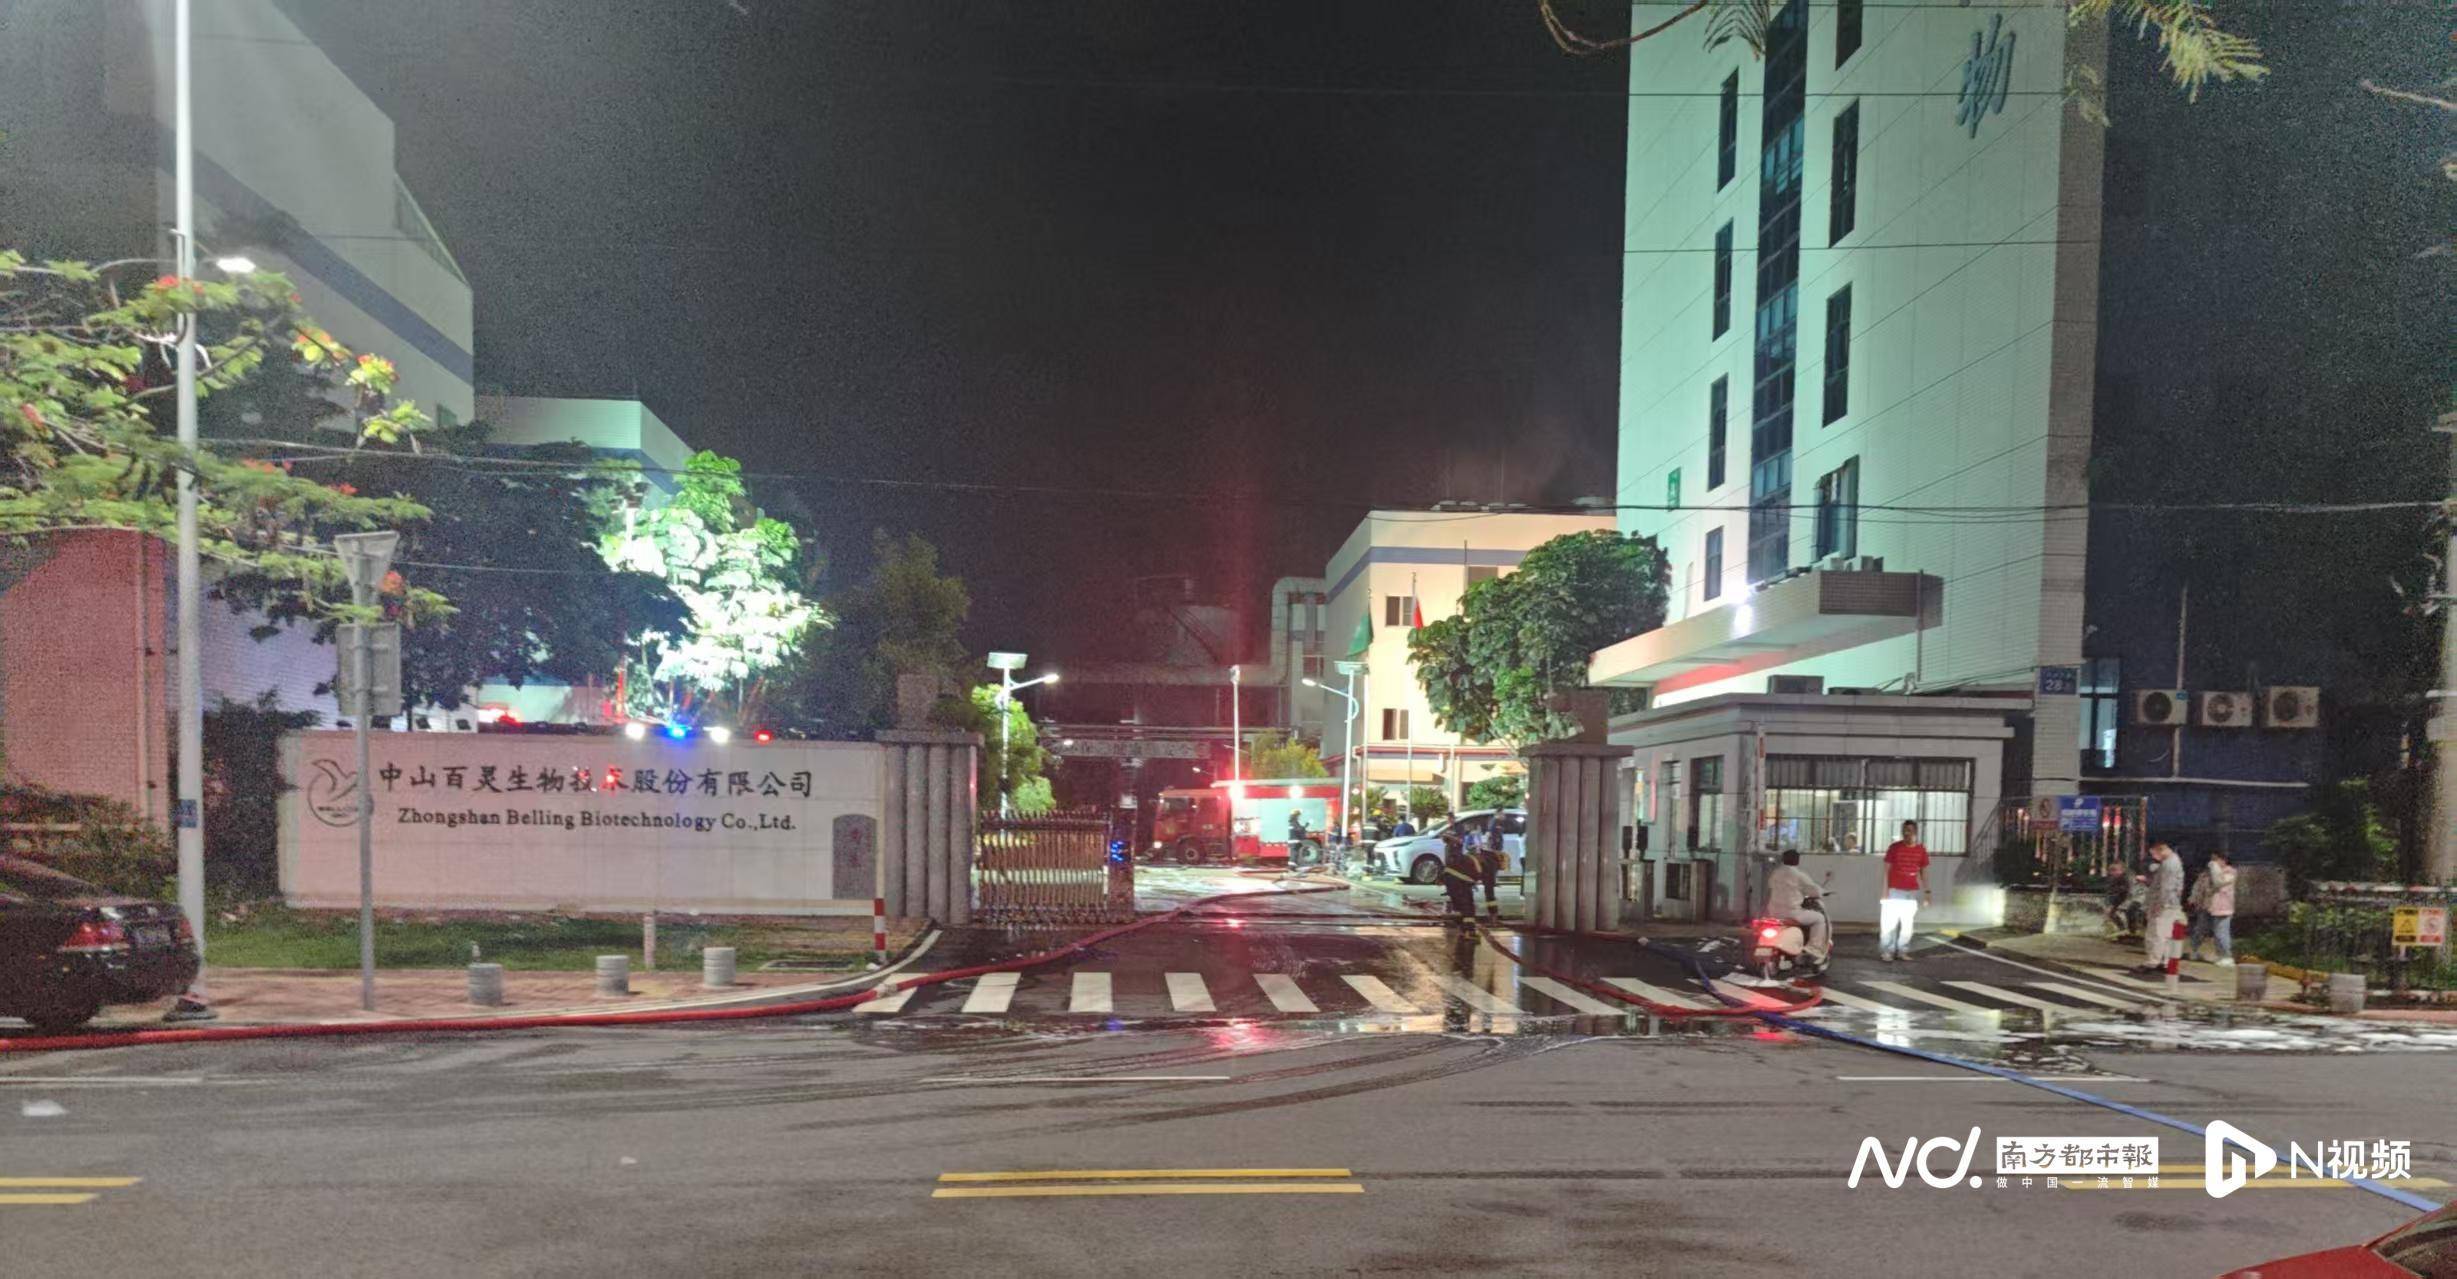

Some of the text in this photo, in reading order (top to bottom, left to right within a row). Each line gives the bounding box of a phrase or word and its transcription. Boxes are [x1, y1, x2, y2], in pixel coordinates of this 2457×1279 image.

[1956, 13, 2017, 139] 物
[398, 808, 500, 827] Zhongshan
[507, 809, 574, 829] Belling
[581, 811, 716, 831] Biotechnology
